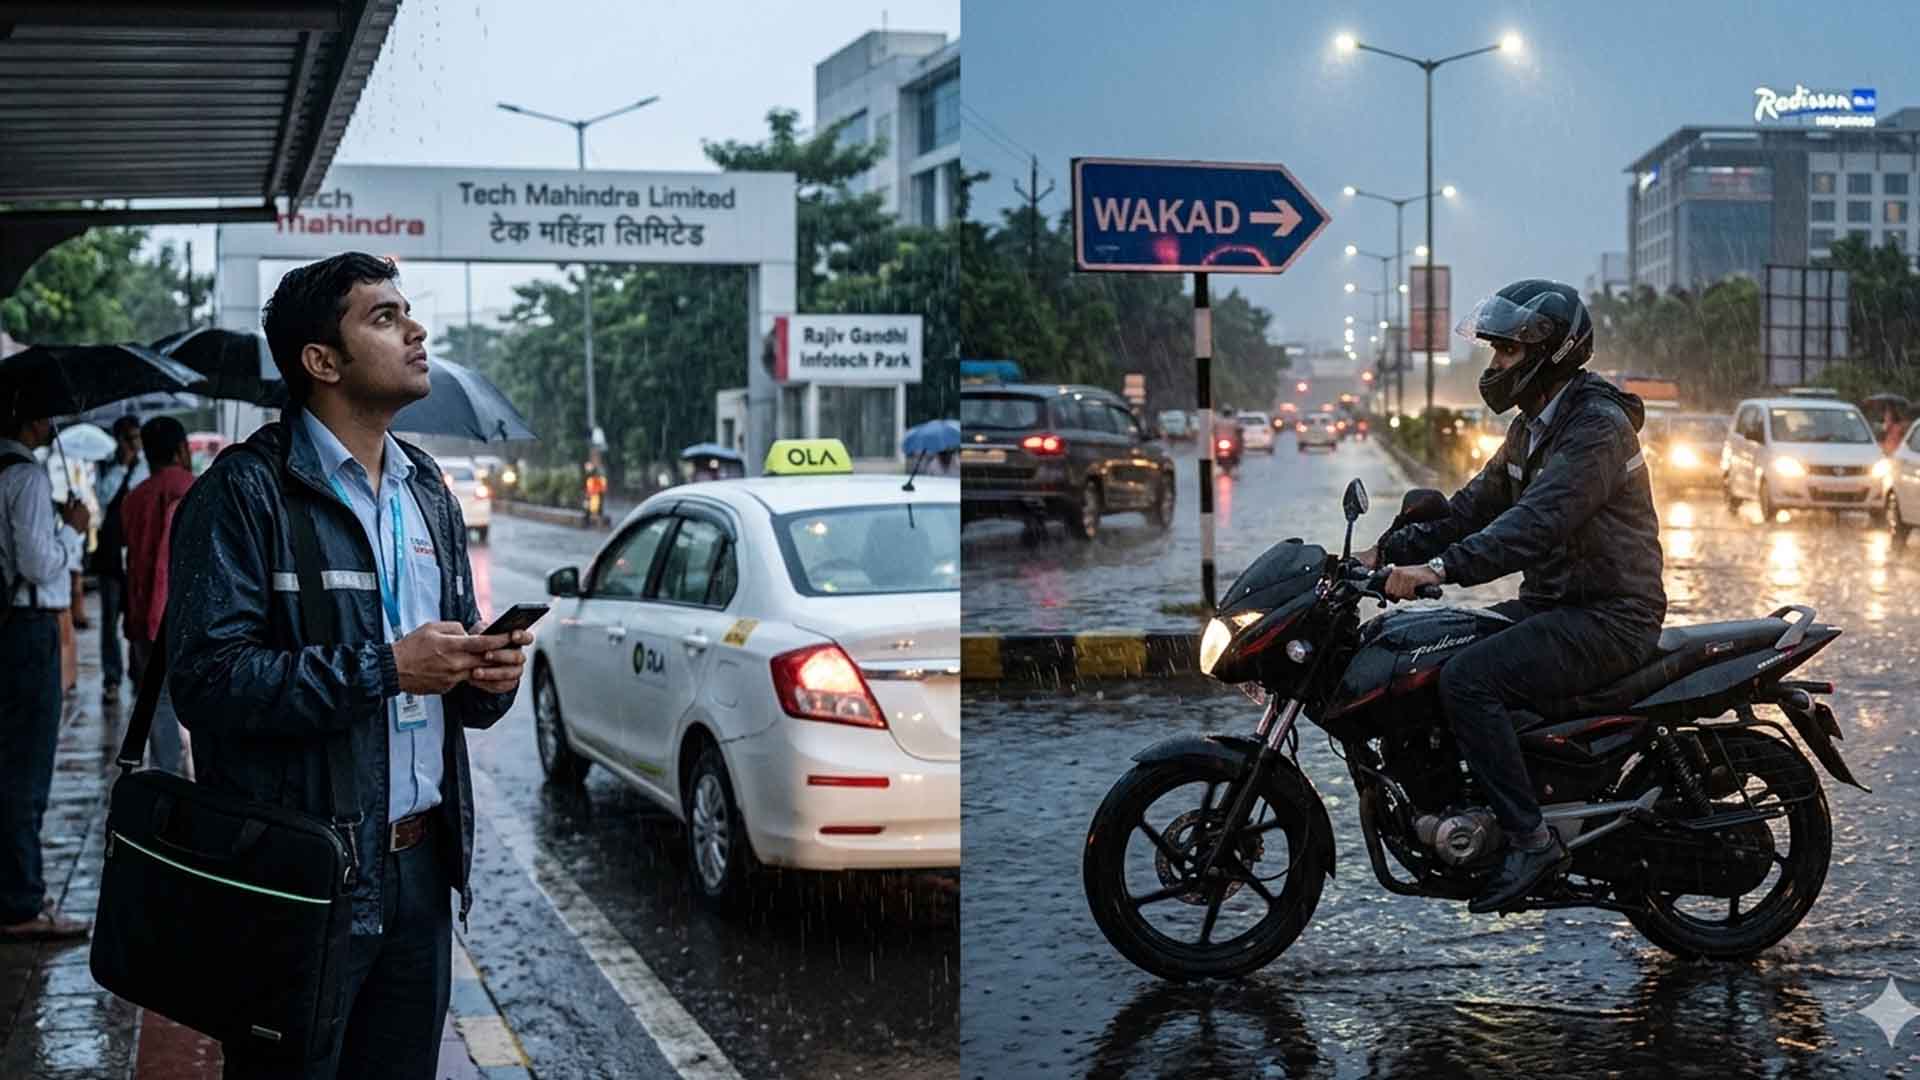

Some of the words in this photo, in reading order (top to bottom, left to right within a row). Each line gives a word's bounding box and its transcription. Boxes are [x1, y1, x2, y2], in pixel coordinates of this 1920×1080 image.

[458, 181, 517, 206] Tech
[525, 182, 640, 208] Mahindra
[648, 184, 736, 210] Limited
[488, 211, 531, 244] टेक
[614, 214, 705, 246] लिमिटेड
[1091, 197, 1241, 235] WAKAD
[803, 326, 845, 349] Rajiv
[850, 326, 909, 345] Gandhi
[800, 351, 869, 369] Infotech
[874, 351, 913, 369] Park
[787, 447, 838, 466] OLA
